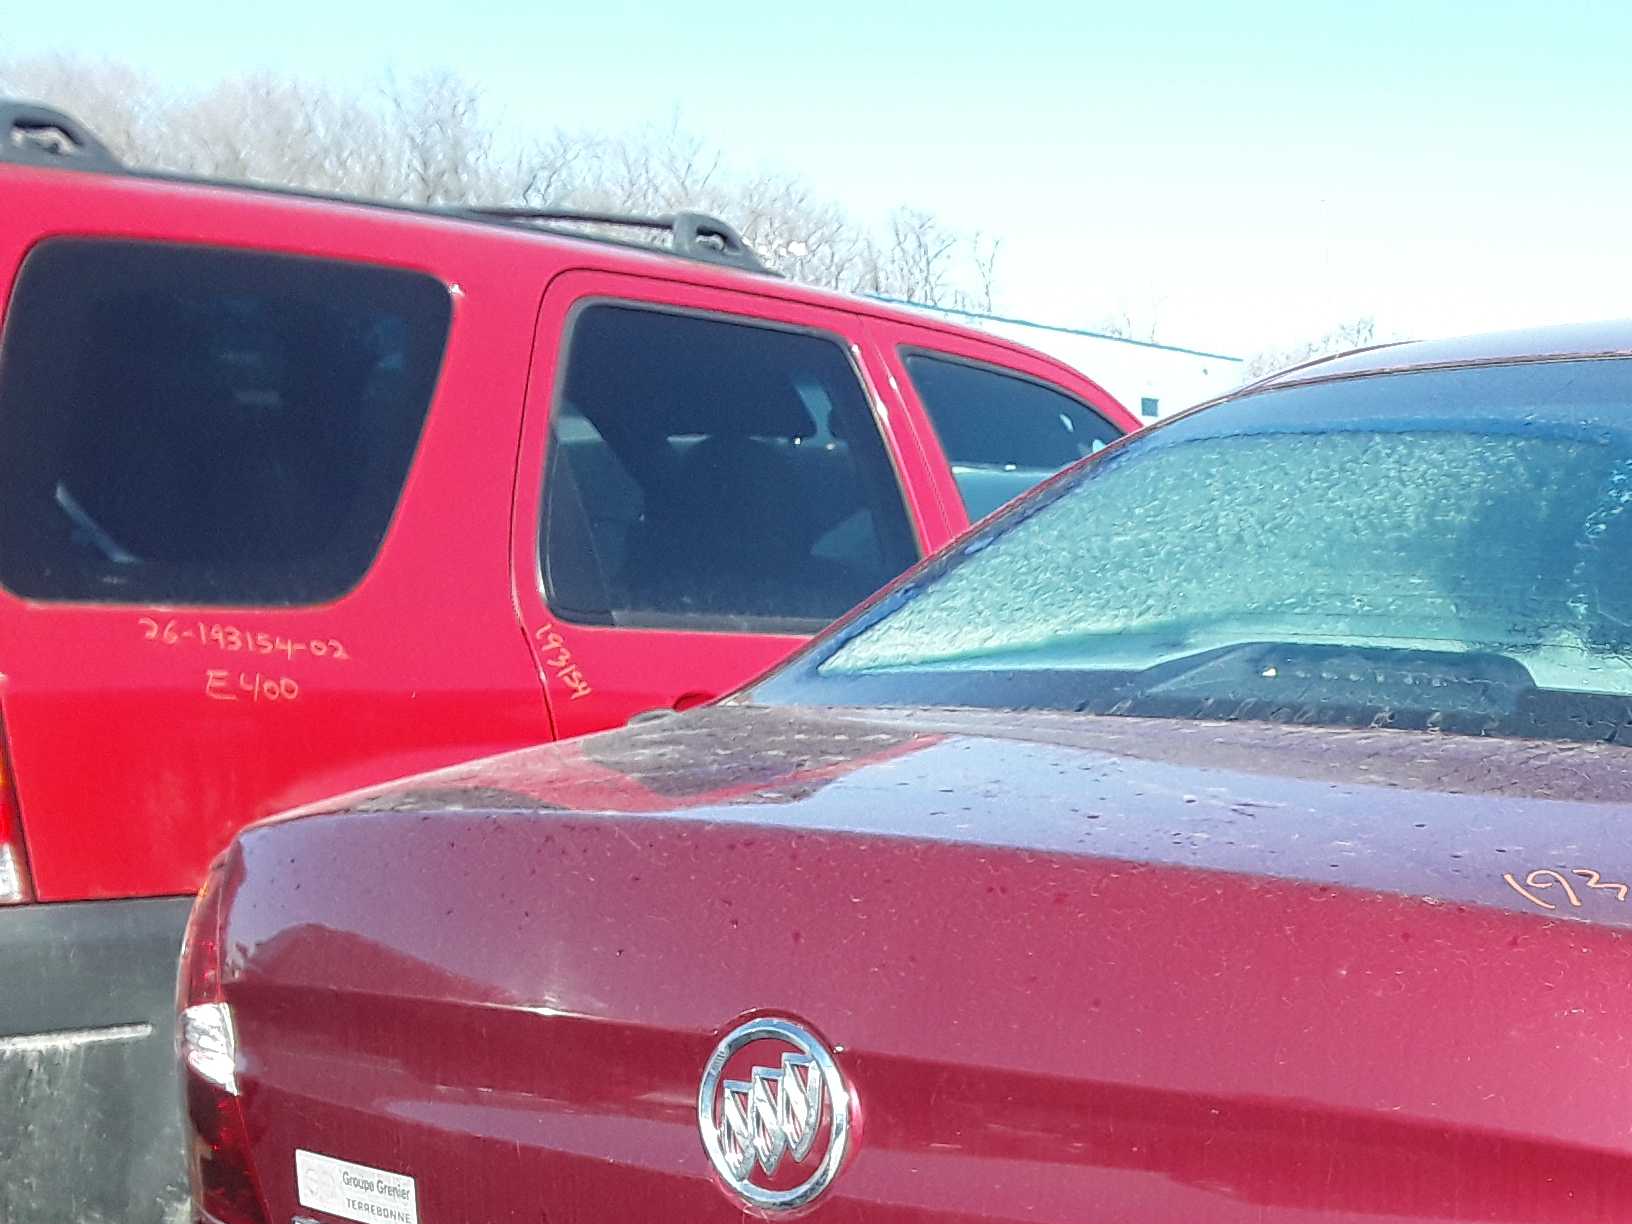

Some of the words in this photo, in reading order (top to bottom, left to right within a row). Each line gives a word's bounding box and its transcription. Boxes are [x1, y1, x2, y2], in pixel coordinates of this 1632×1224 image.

[137, 616, 350, 661] 26-193154-02
[534, 622, 593, 700] 193154
[205, 668, 299, 702] E400
[341, 1170, 375, 1193] Groupe
[376, 1179, 411, 1201] Grenier
[344, 1197, 413, 1224] TERREBONNE
